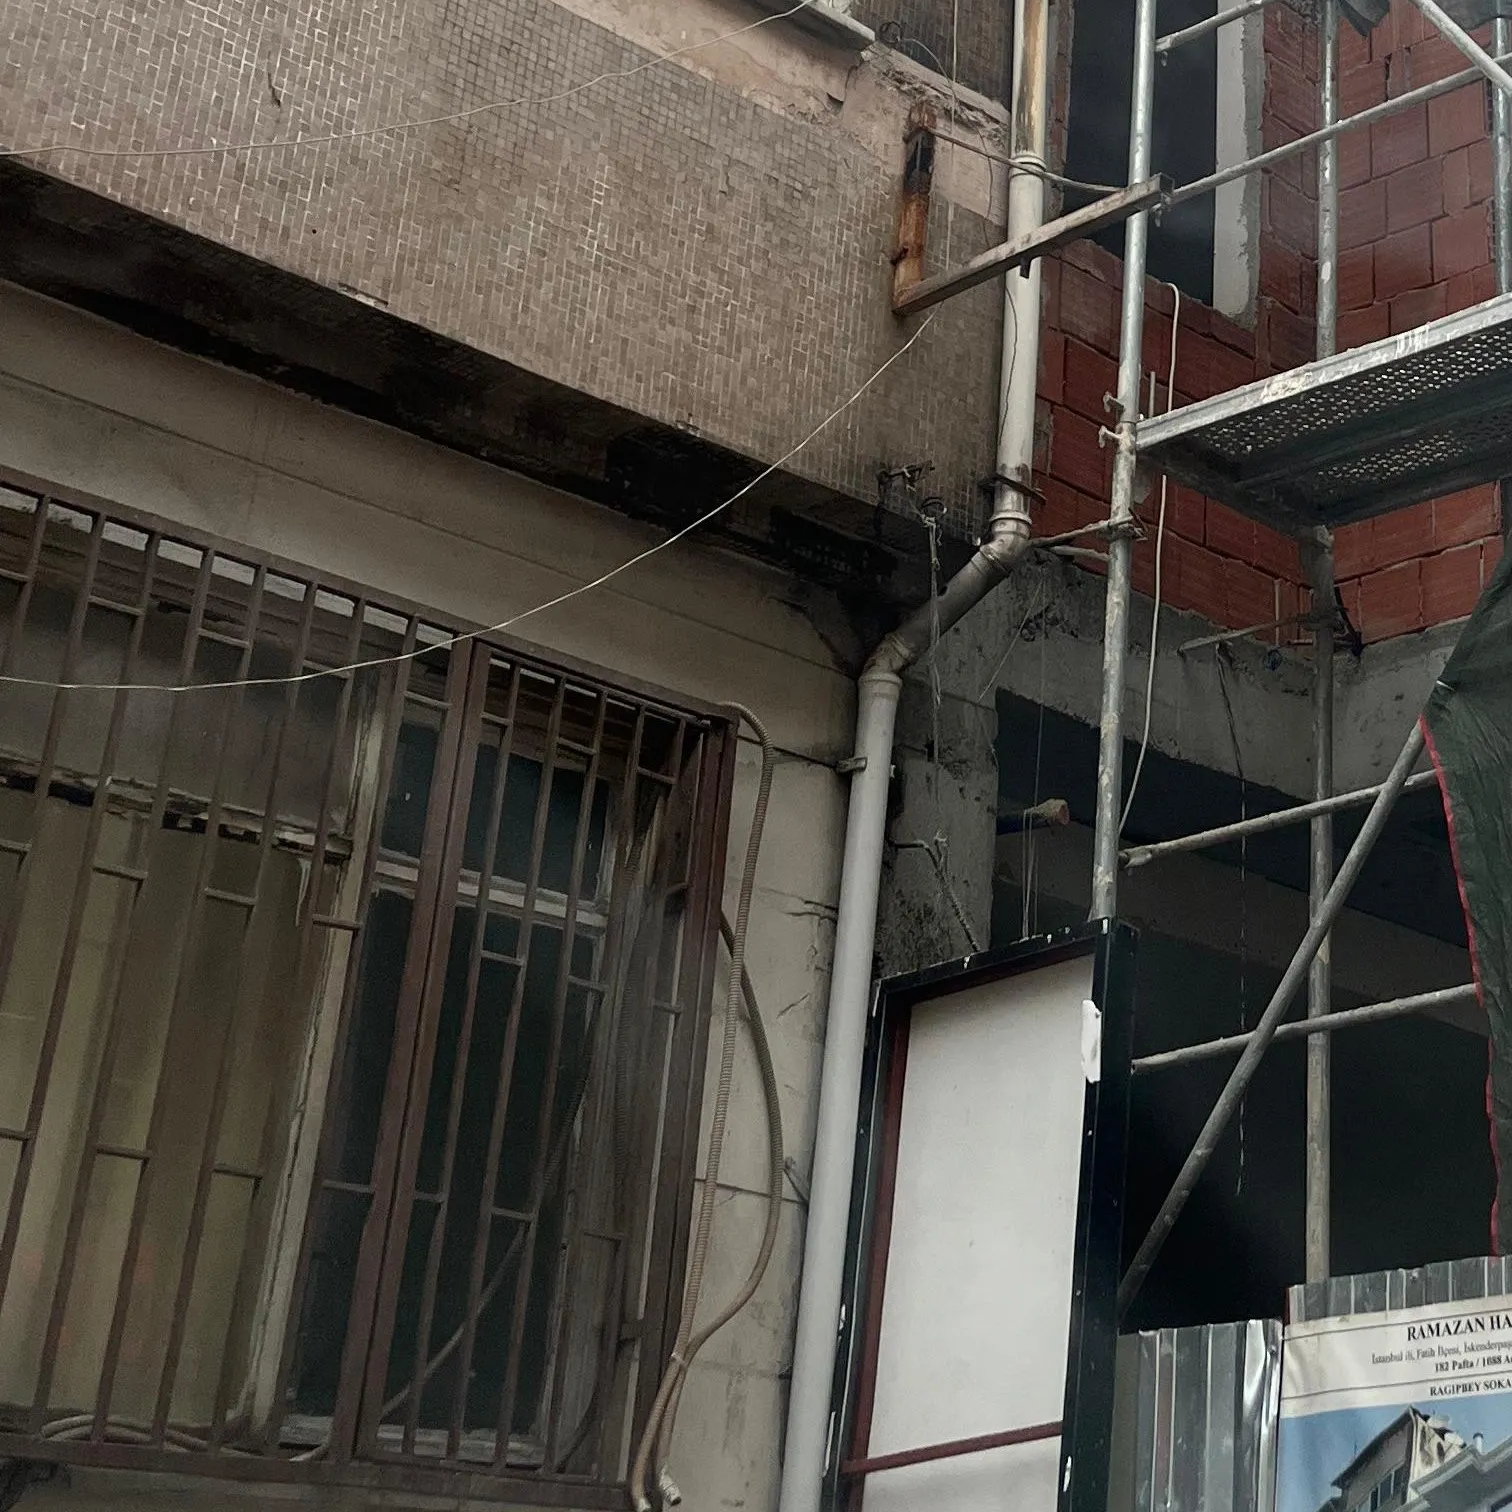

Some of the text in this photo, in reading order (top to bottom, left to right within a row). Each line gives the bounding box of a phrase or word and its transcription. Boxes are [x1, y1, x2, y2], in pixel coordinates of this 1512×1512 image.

[1407, 1316, 1485, 1341] RAMAZAN
[1435, 1362, 1449, 1373] 182
[1452, 1358, 1474, 1371] Pafta
[1430, 1382, 1481, 1397] RAGIPBEY
